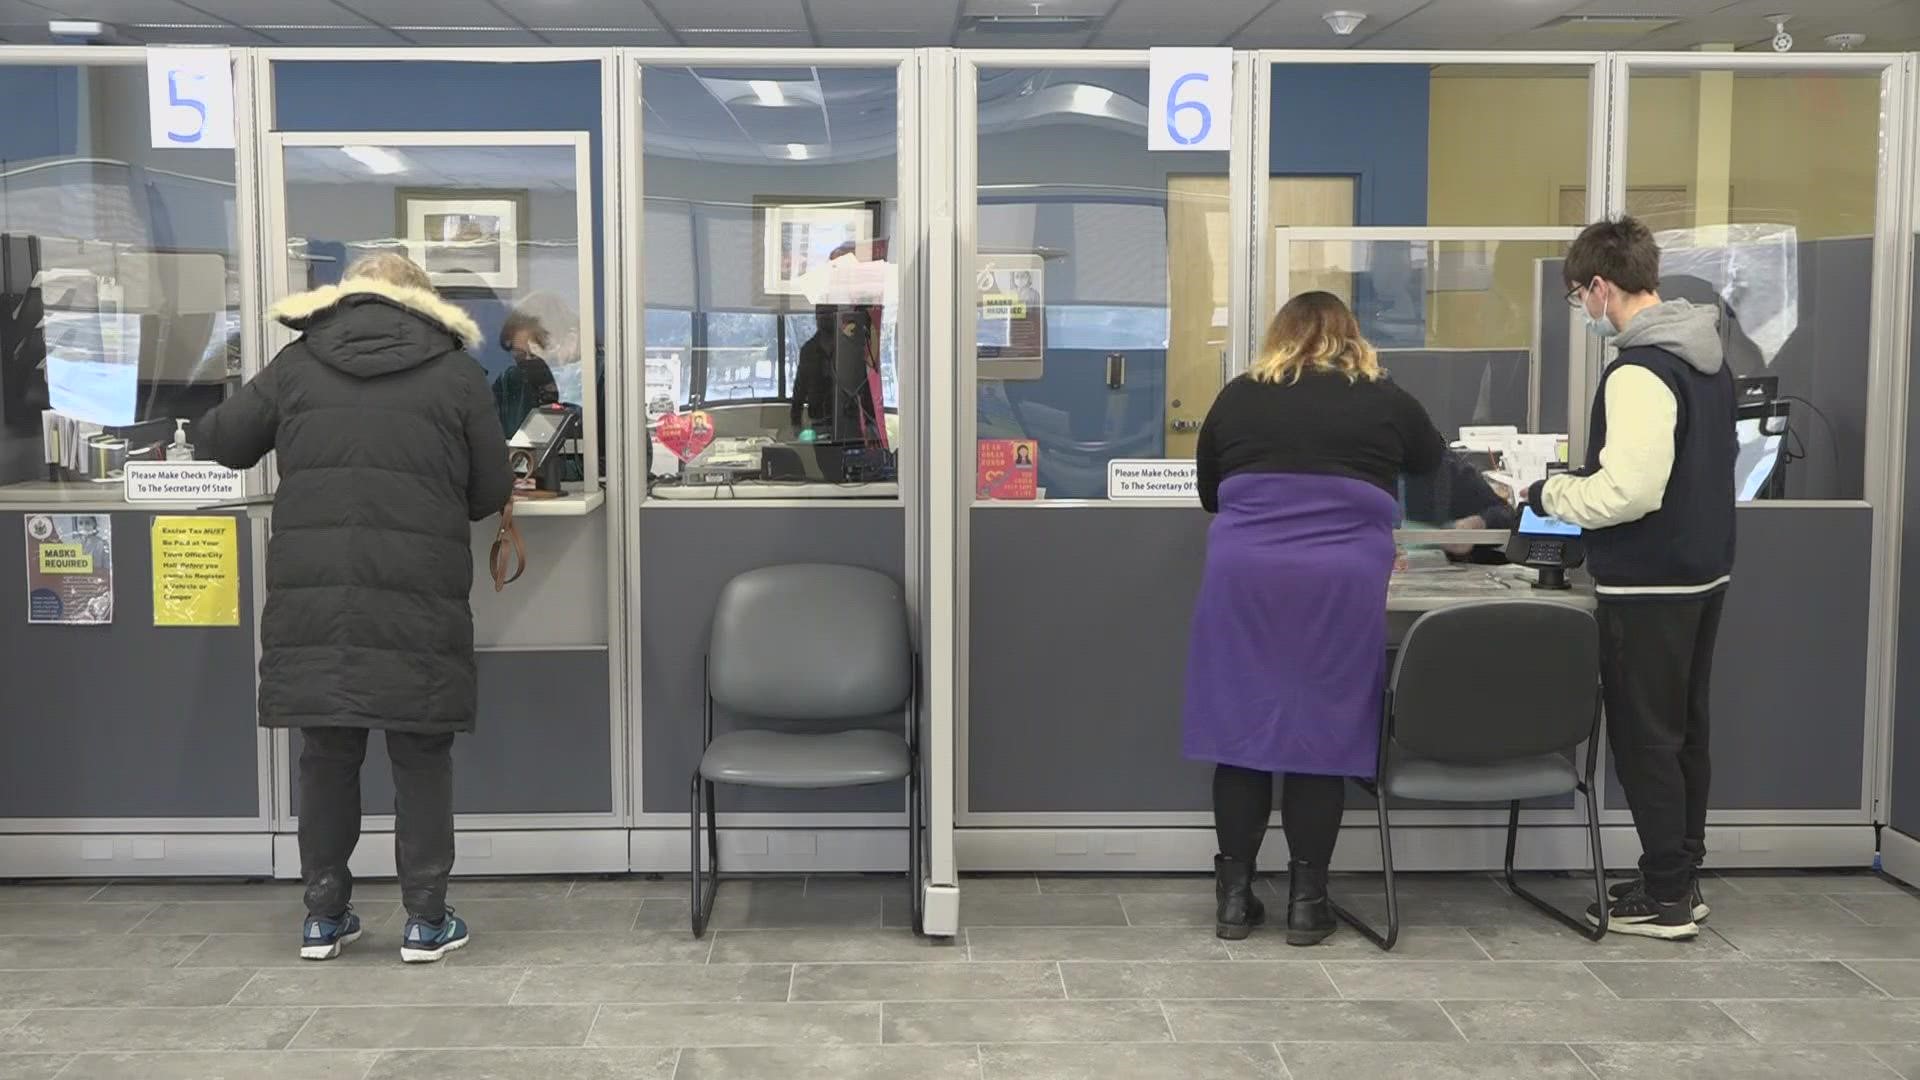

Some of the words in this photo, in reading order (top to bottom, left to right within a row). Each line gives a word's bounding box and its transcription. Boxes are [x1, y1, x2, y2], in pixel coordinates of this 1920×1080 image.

[168, 70, 206, 143] 5
[1167, 73, 1211, 145] 6
[131, 471, 157, 480] Please
[158, 471, 179, 480] Make
[180, 471, 206, 480] Checks
[208, 471, 239, 482] Payable
[1115, 468, 1140, 477] Please
[1141, 468, 1162, 477] Make
[1163, 468, 1189, 477] Checks
[138, 484, 146, 493] To
[148, 484, 162, 493] The
[163, 484, 200, 494] Secretary
[201, 484, 211, 493] Of
[212, 484, 232, 493] State
[1120, 481, 1129, 490] To
[1131, 481, 1145, 490] The
[1146, 481, 1182, 492] Secretary
[1183, 481, 1193, 490] Of
[162, 527, 187, 535] Excise
[188, 527, 202, 535] Tax
[203, 527, 226, 535] MUST
[44, 549, 76, 558] MASKS
[45, 559, 88, 568] REQUIRED
